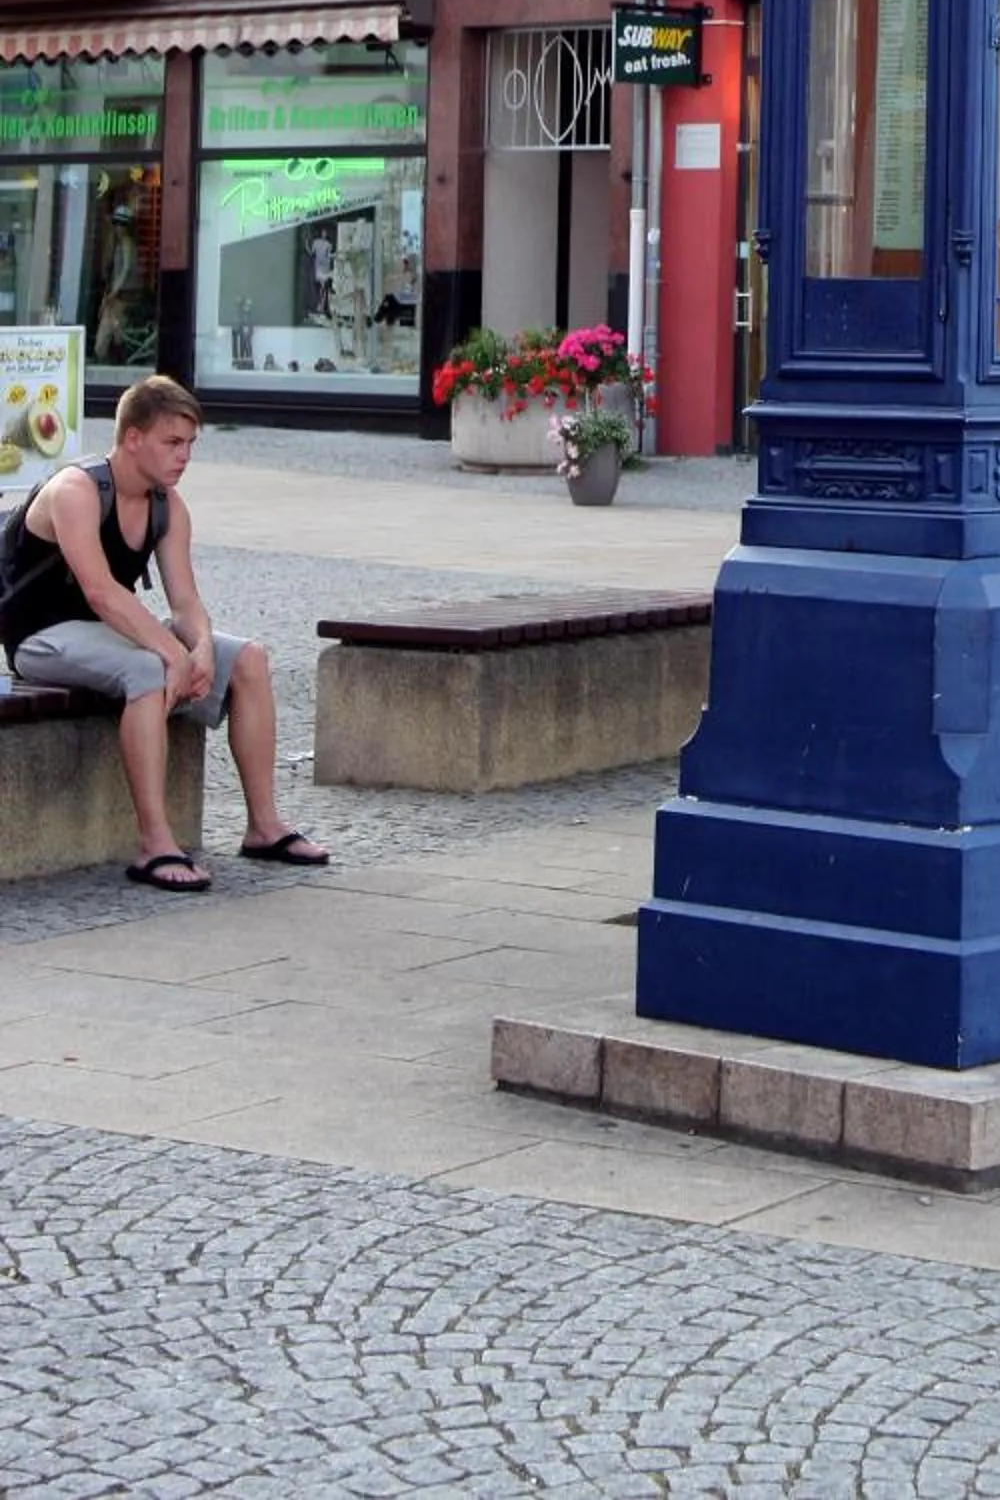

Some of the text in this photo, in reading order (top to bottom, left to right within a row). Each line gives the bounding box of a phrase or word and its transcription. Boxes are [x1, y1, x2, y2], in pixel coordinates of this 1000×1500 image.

[618, 24, 692, 50] SUBWAY
[624, 52, 691, 73] eat fresh.
